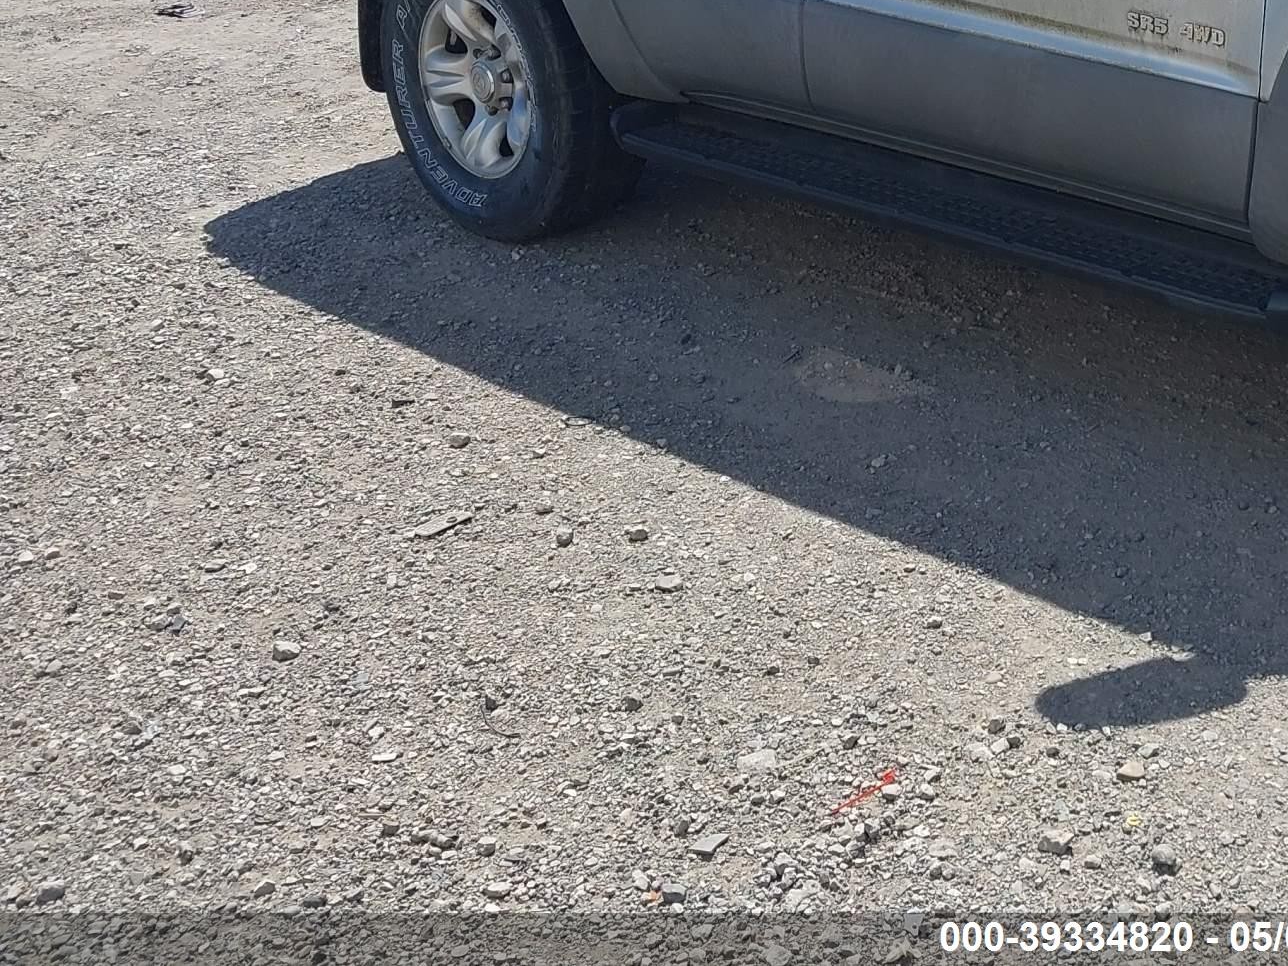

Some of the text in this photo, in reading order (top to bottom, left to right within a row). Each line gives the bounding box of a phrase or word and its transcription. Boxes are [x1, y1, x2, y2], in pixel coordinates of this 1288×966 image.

[1127, 10, 1226, 47] SR5 4WD
[392, 39, 488, 207] ADVENTURER
